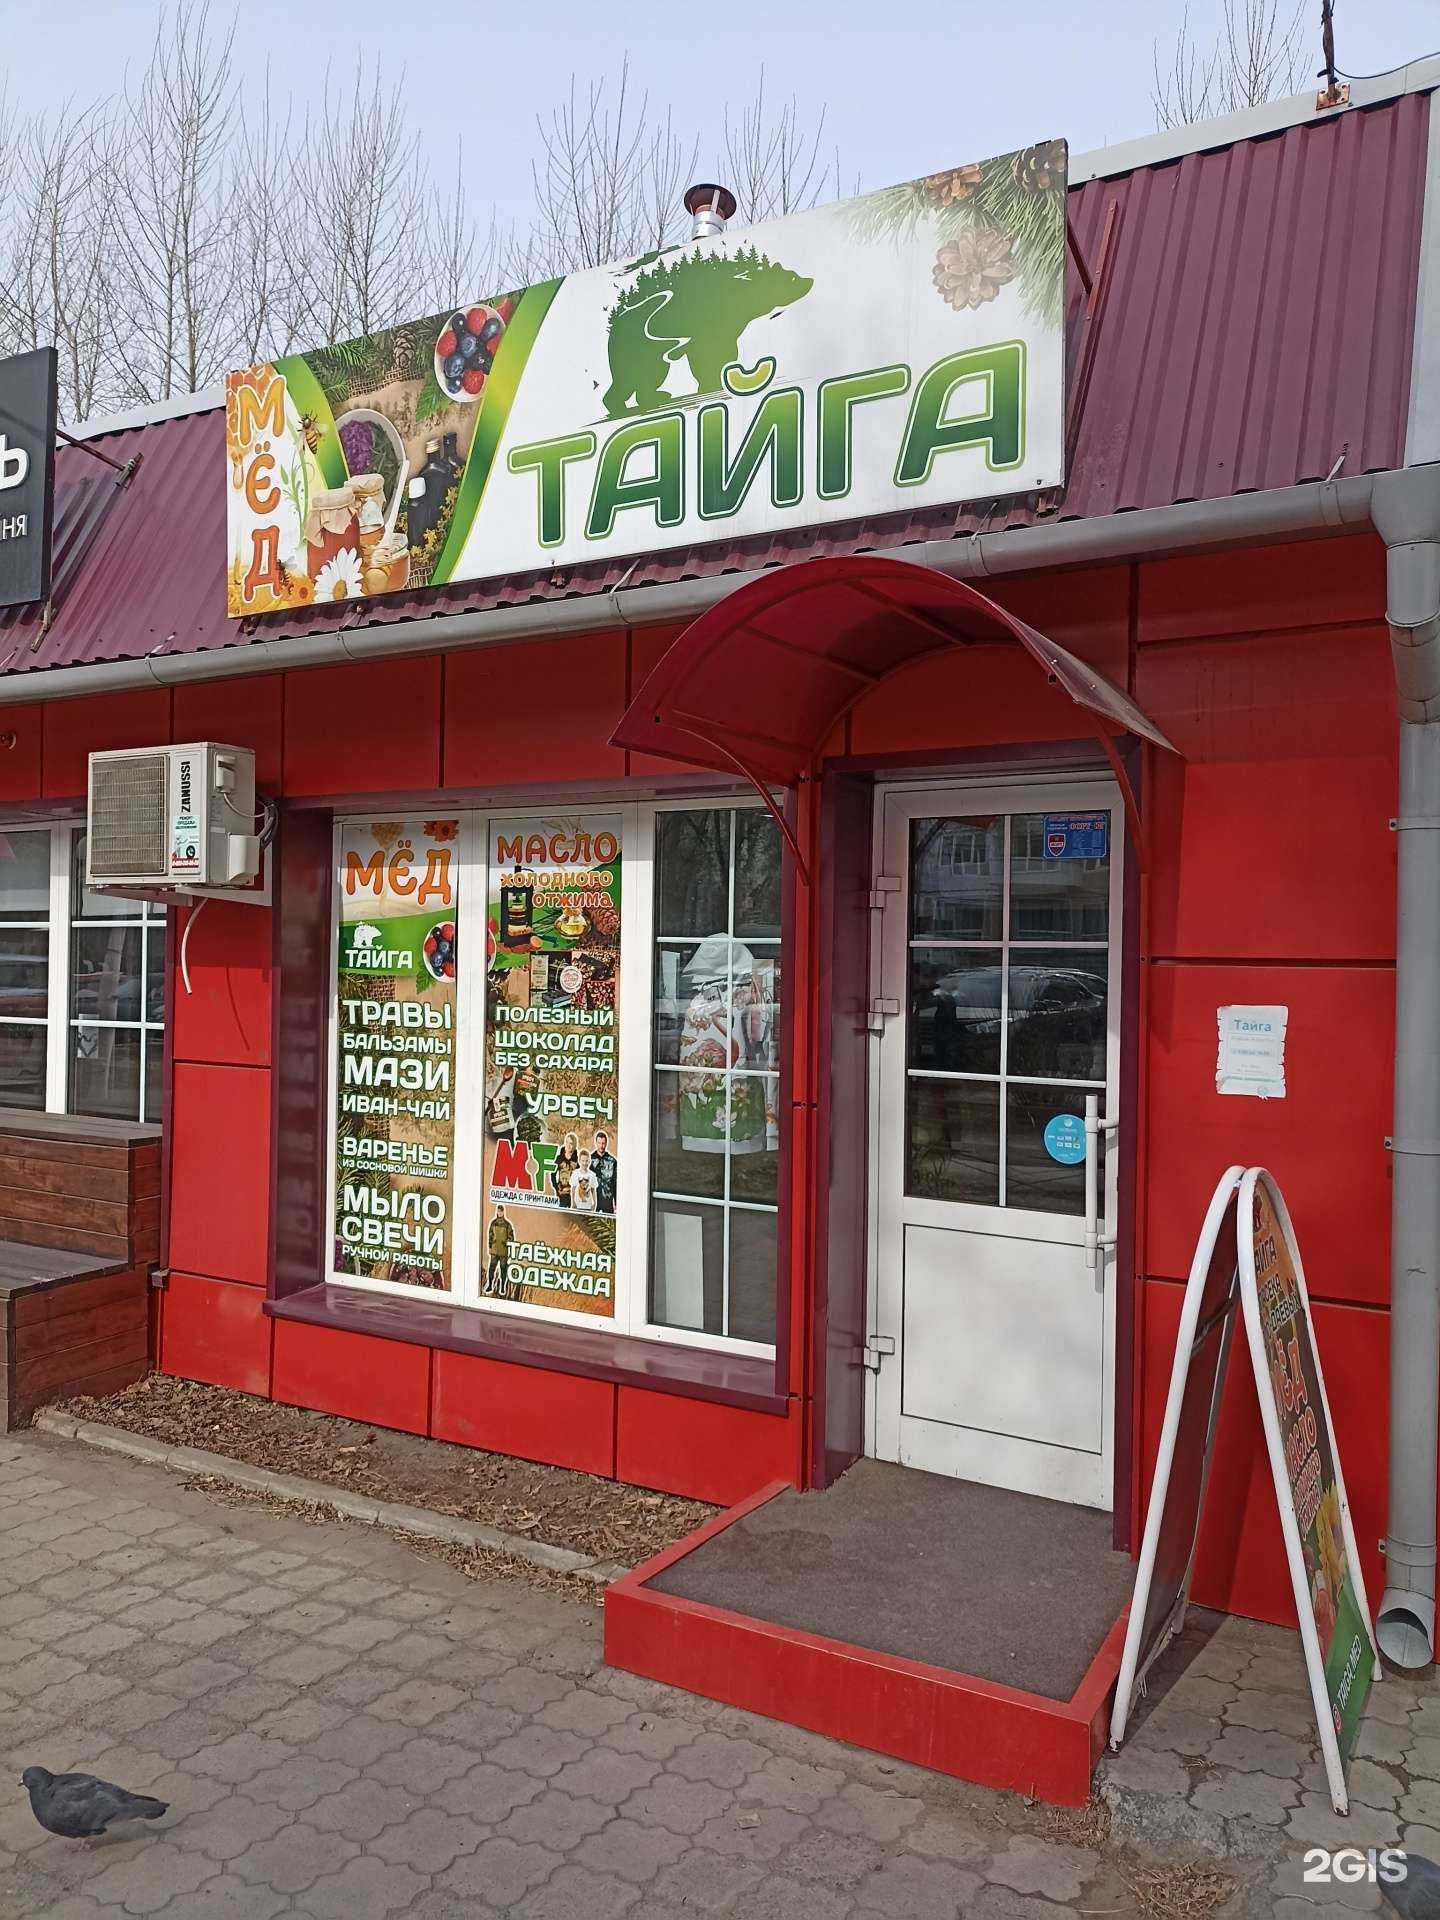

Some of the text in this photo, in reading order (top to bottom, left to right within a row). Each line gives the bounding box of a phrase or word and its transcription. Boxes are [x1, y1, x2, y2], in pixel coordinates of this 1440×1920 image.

[507, 339, 1027, 548] ТАЙГА
[237, 374, 287, 604] МЁД
[181, 761, 191, 812] ZANUSSI
[496, 831, 619, 865] МАСЛО
[345, 839, 452, 905] МЁД
[345, 944, 413, 969] ТАЙГА
[341, 1000, 452, 1029] ТРАВЫ
[496, 1006, 614, 1026] ПОЛЕЗНЫЙ
[343, 1033, 452, 1055] БАЛЬЗАМЫ
[495, 1030, 614, 1053] ШОКОЛАД
[344, 1055, 450, 1092] МАЗИ
[495, 1052, 613, 1072] БЕЗ САХАРА
[342, 1094, 450, 1121] ИВАН-ЧАЙ
[525, 1092, 613, 1120] УРБЕЧ
[343, 1136, 449, 1167] ВАРЕНЬЕ
[342, 1159, 447, 1179] ИЗ СОСНОВОЙ ШИШКИ
[343, 1184, 446, 1224] МЫЛО
[525, 1193, 559, 1205] ПРИНТАМИ
[341, 1216, 444, 1255] СВЕЧИ
[342, 1244, 443, 1271] РУЧНОЙ РАБОТЫ
[507, 1240, 612, 1273] ТАЁЖНАЯ
[507, 1262, 611, 1298] ОДЕЖДА
